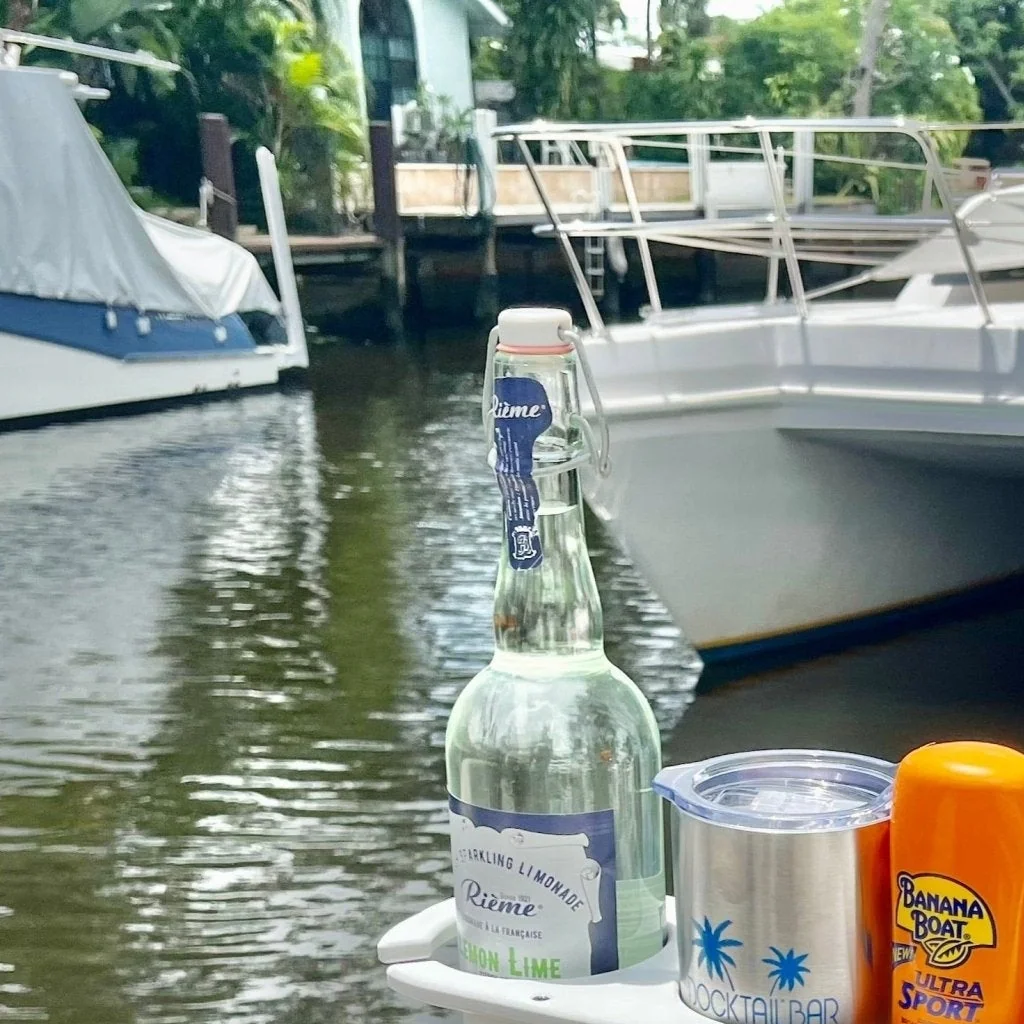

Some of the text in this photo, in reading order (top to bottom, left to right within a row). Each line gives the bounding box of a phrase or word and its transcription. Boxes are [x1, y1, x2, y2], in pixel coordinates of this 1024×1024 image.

[461, 878, 538, 917] Rième
[519, 861, 584, 912] LIMONADE
[901, 876, 984, 919] BANANA
[911, 910, 968, 939] BOAT
[509, 946, 561, 978] LIME
[898, 980, 984, 1023] SPORT
[916, 970, 984, 1000] ULTRA
